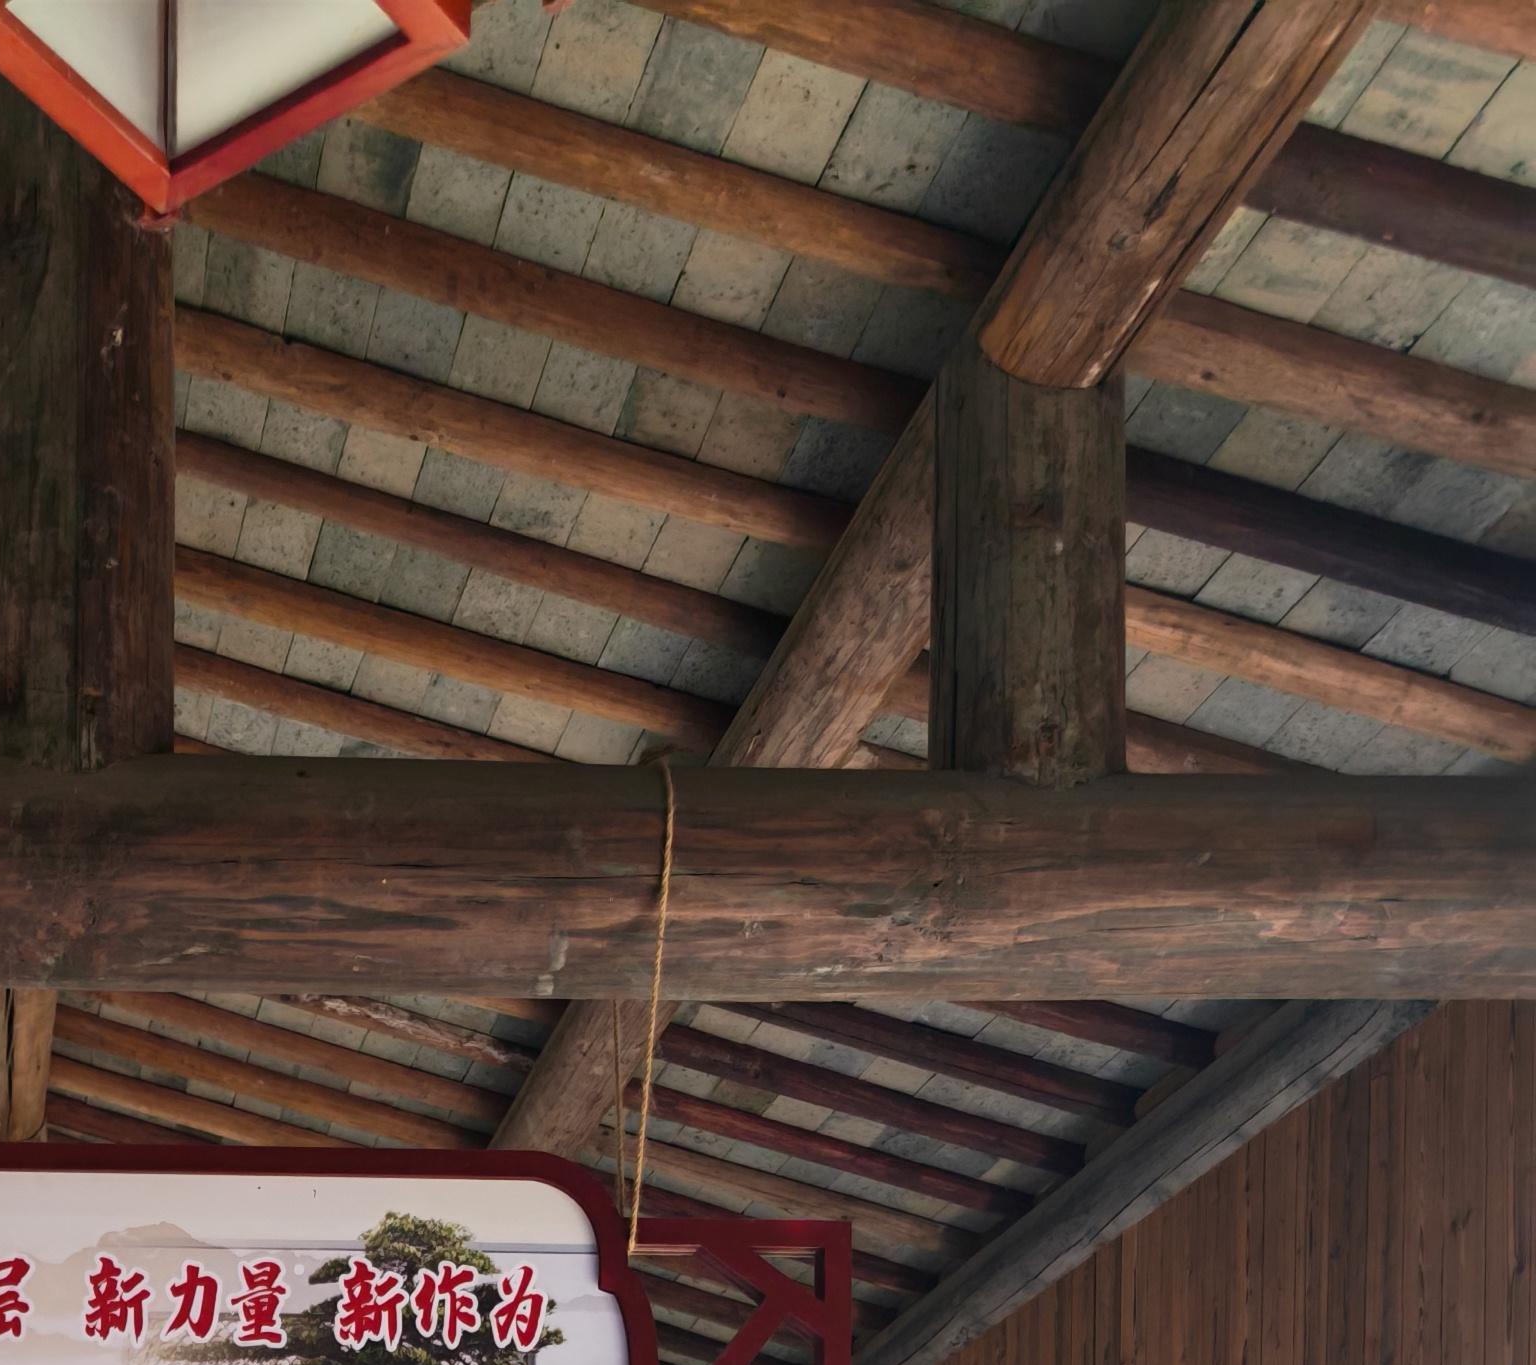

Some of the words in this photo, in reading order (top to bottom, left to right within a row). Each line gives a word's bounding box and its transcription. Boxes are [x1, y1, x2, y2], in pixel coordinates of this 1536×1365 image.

[84, 1256, 288, 1346] 新力量
[336, 1260, 546, 1350] 新作为
